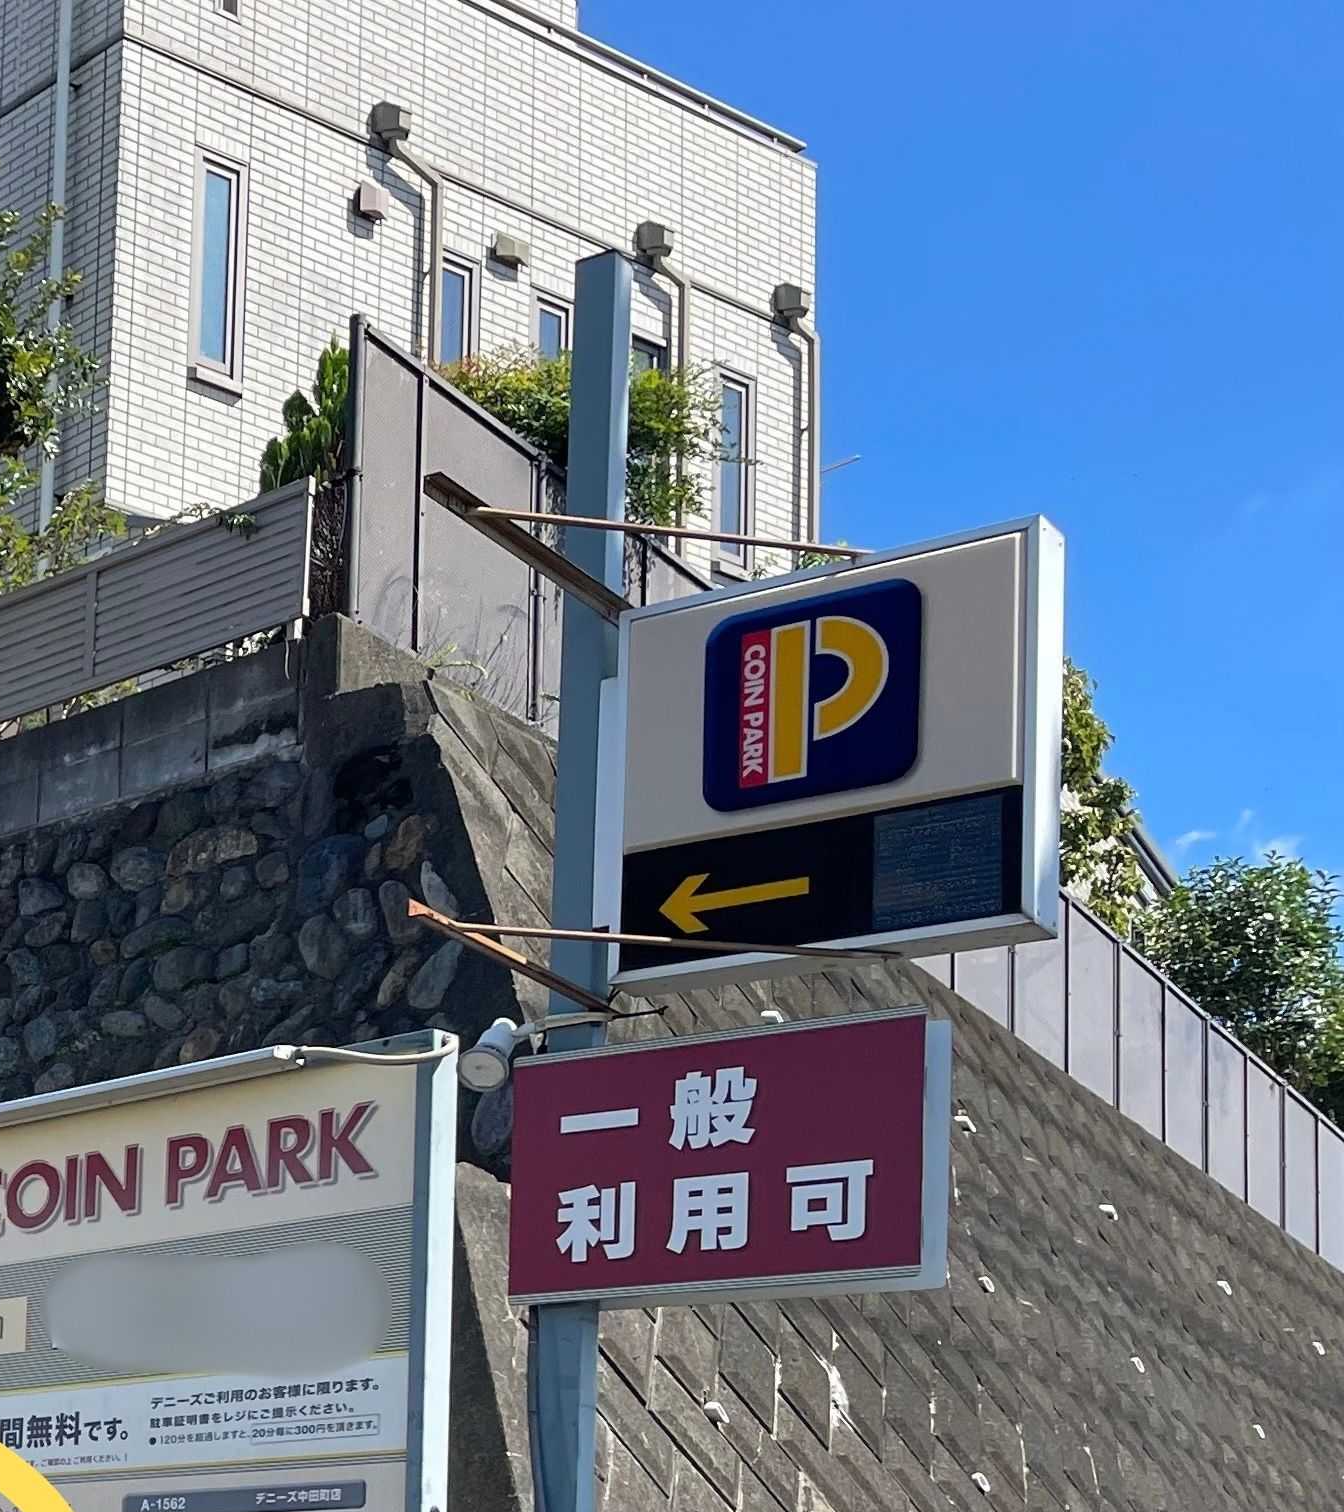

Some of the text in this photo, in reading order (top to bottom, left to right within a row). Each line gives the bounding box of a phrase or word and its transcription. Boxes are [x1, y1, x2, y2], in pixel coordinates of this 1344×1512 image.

[740, 643, 766, 777] COIN PARK
[559, 1067, 758, 1152] 一般
[165, 1100, 377, 1209] PARK
[556, 1159, 875, 1264] 利用可
[149, 1402, 355, 1429] 駐車証明書をレジにご提示ください。
[150, 1377, 380, 1410] デニーズご利用のお客様に限ります。
[140, 1497, 187, 1512] A-1562
